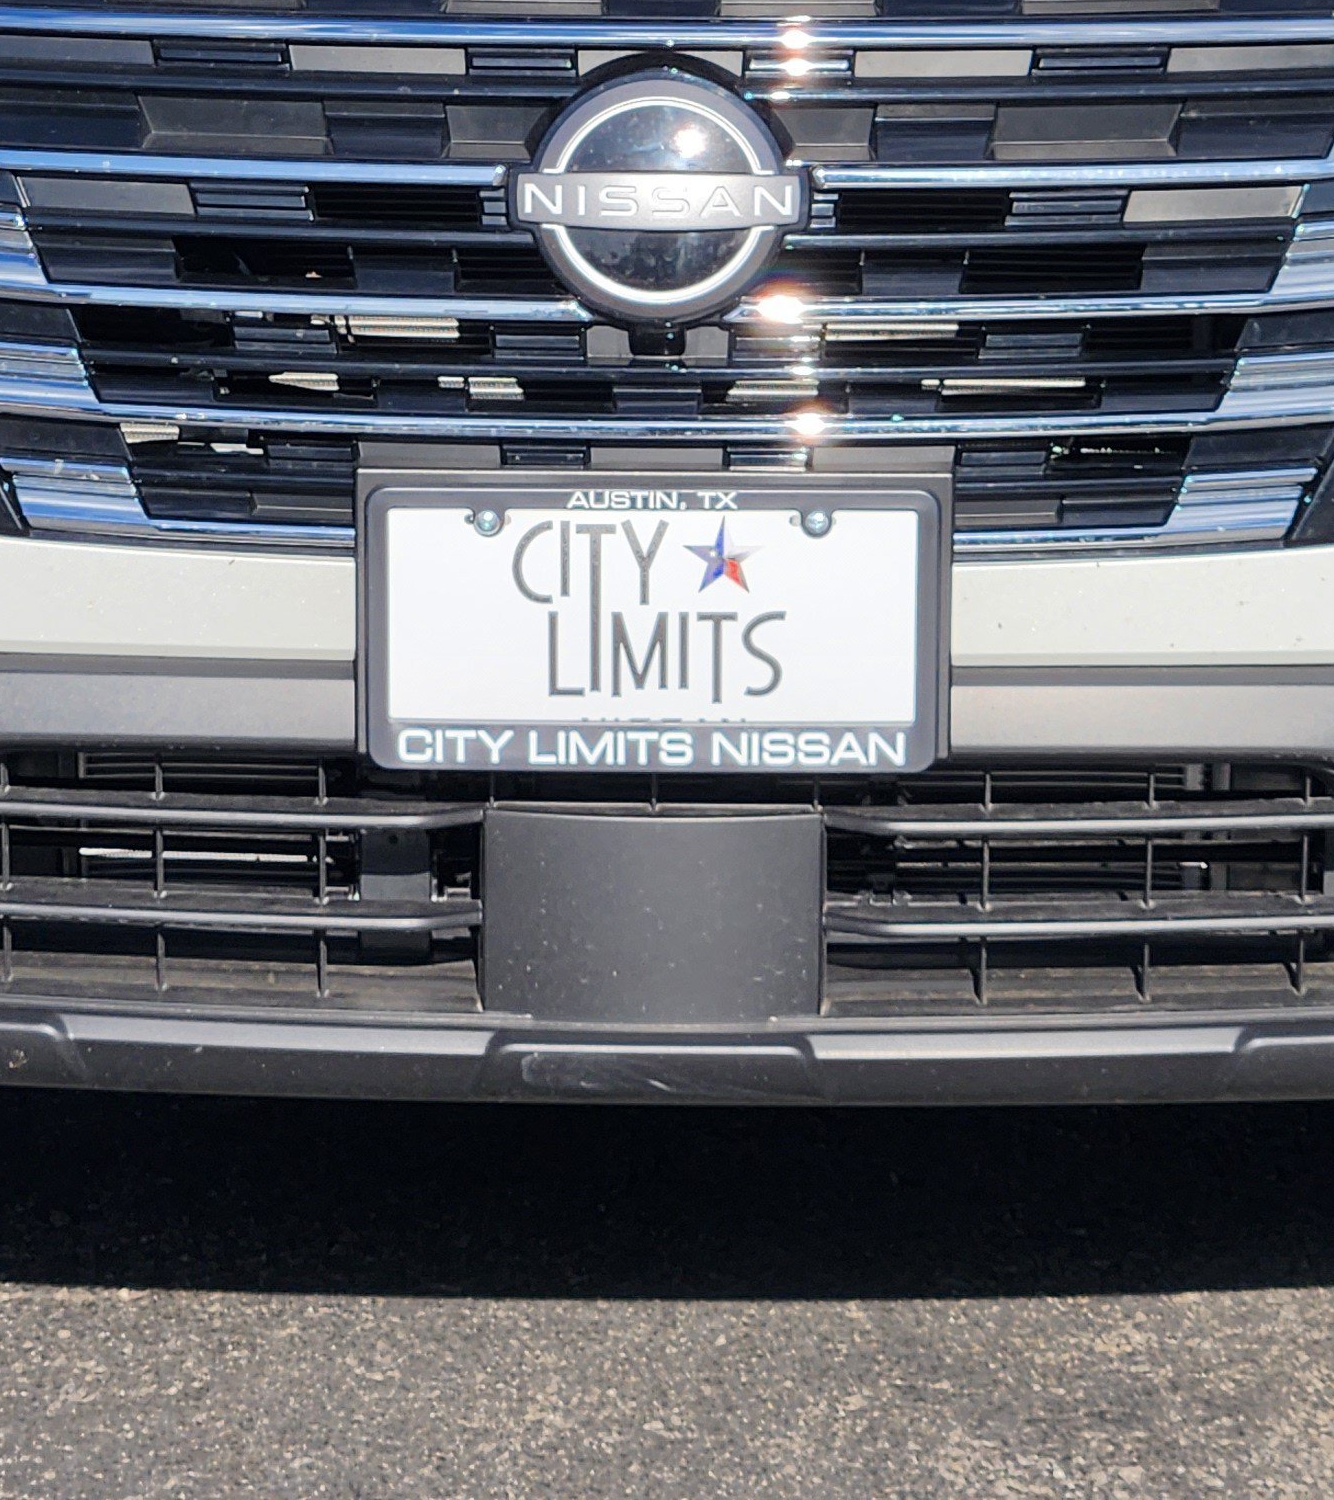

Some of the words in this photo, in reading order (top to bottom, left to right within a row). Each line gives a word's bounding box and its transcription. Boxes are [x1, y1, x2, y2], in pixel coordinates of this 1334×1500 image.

[523, 183, 794, 219] NISSAN
[566, 489, 688, 511] AUSTIN,
[696, 490, 739, 510] TX
[548, 610, 787, 704] LIMITS
[397, 728, 514, 765] CITY
[528, 730, 694, 766] LIMITS
[710, 731, 907, 767] NISSAN
